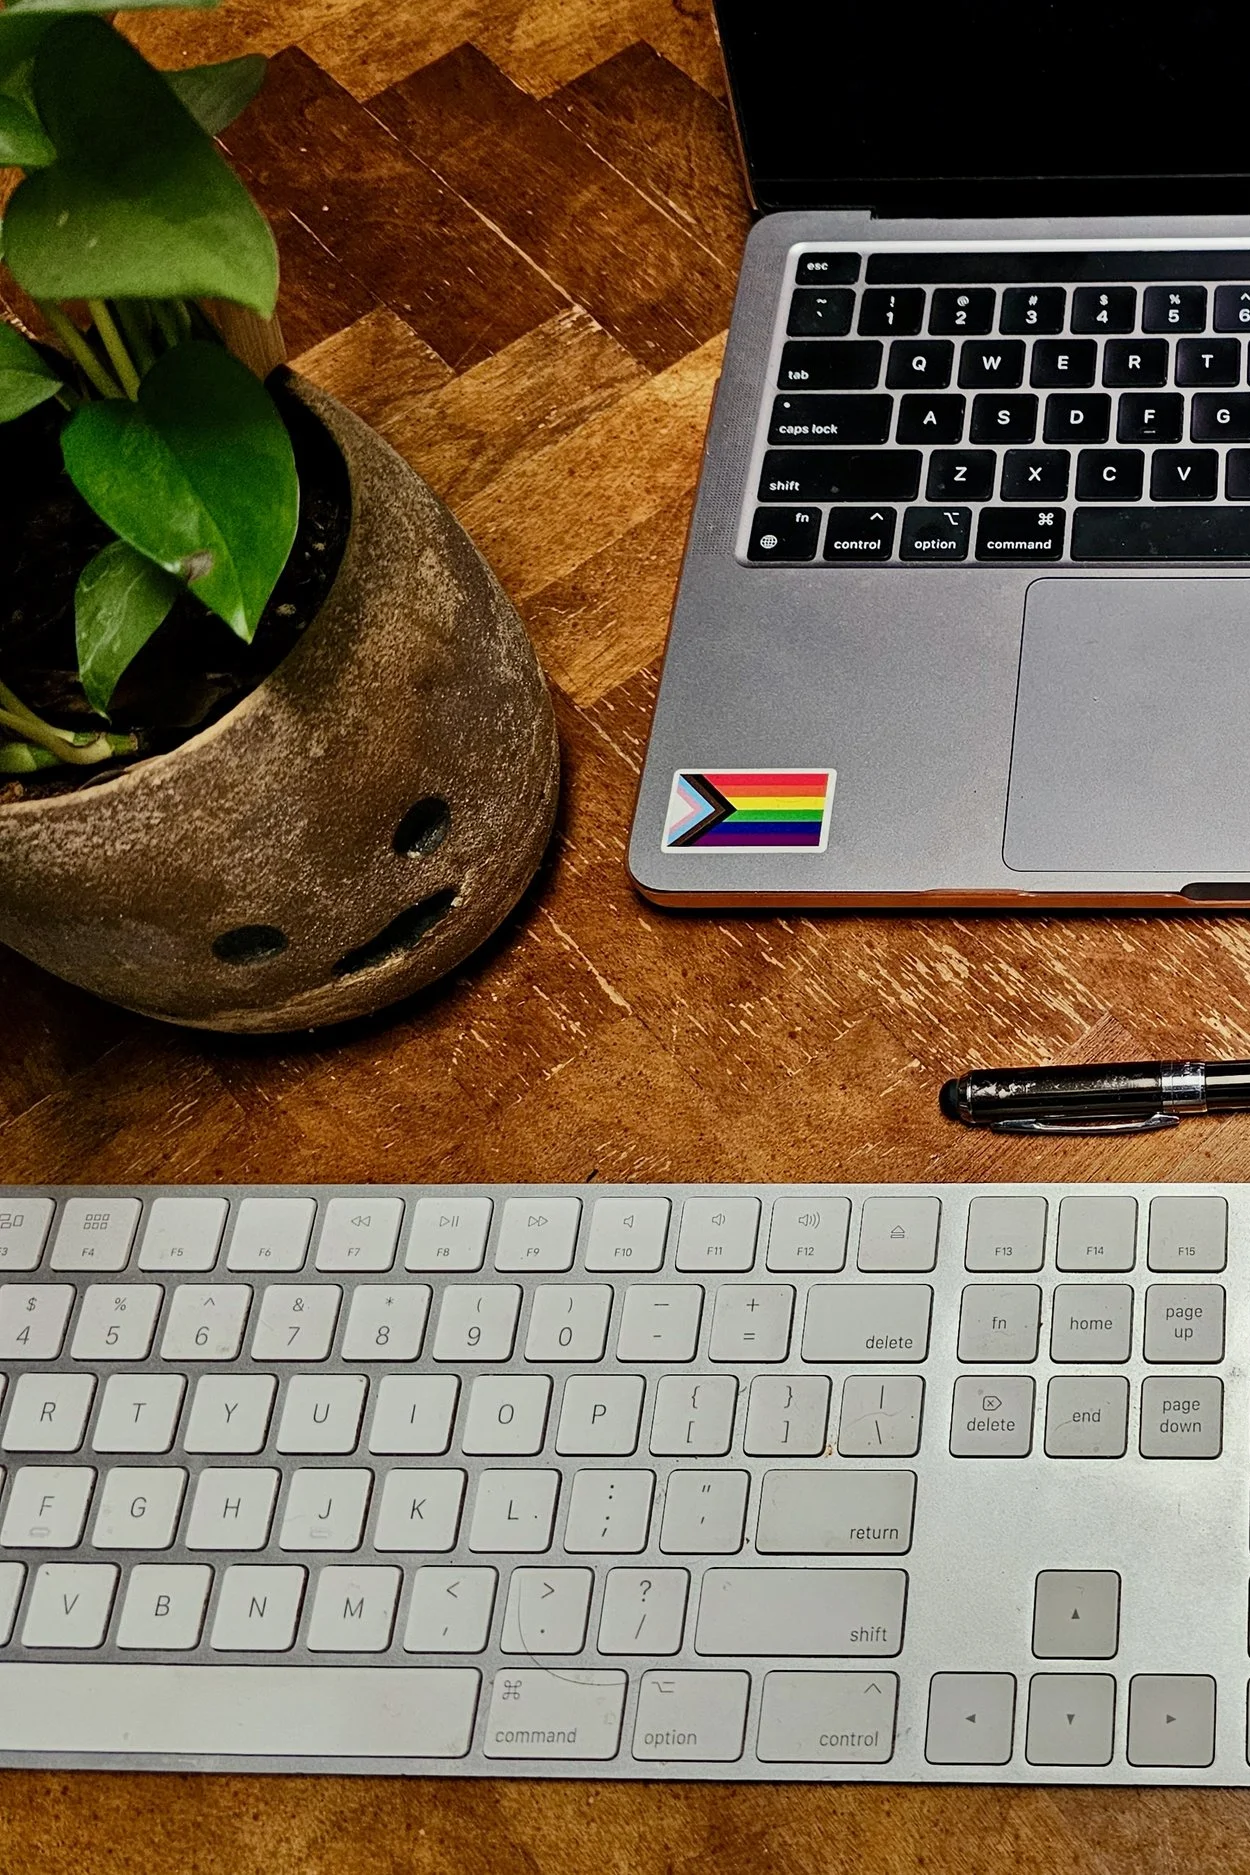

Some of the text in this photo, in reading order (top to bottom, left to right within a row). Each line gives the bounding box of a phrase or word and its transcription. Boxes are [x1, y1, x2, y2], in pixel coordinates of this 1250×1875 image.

[806, 262, 829, 271] esc
[955, 311, 966, 324] 2
[1026, 310, 1037, 324] 3
[1097, 310, 1108, 323] 4
[1168, 310, 1179, 322] 5
[1239, 309, 1250, 322] 6
[912, 356, 926, 371] Q
[983, 356, 1001, 370] W
[1058, 356, 1069, 369] E
[1129, 355, 1141, 368] R
[1202, 355, 1213, 368] T
[789, 370, 809, 379] tab
[923, 411, 936, 424] A
[998, 410, 1010, 424] S
[1070, 410, 1083, 424] D
[1145, 410, 1155, 423] F
[1217, 409, 1230, 423] G
[779, 424, 837, 435] caps lock
[954, 467, 967, 481] Z
[1028, 467, 1042, 481] X
[1103, 467, 1116, 481] C
[1178, 467, 1191, 480] V
[770, 481, 799, 491] shift
[796, 513, 809, 522] fn
[834, 540, 880, 549] control
[915, 539, 956, 550] option
[987, 540, 1051, 549] command
[82, 1248, 94, 1256] F4
[171, 1248, 183, 1256] F5
[259, 1248, 271, 1256] F6
[348, 1248, 360, 1256] F7
[437, 1248, 449, 1256] F8
[527, 1248, 539, 1256] F9
[615, 1248, 632, 1256] F10
[707, 1247, 722, 1255] F11
[797, 1247, 814, 1255] F12
[995, 1247, 1012, 1255] F13
[1087, 1247, 1103, 1255] F14
[1179, 1247, 1195, 1255] F15
[1166, 1308, 1202, 1320] page
[993, 1317, 1006, 1329] fn
[1071, 1317, 1112, 1329] home
[16, 1326, 30, 1344] 4
[106, 1326, 120, 1345] 5
[195, 1326, 209, 1345] 6
[288, 1327, 300, 1345] 7
[376, 1326, 390, 1345] 8
[467, 1327, 480, 1346] 9
[559, 1327, 572, 1346] 0
[1175, 1328, 1193, 1341] up
[866, 1336, 912, 1349] delete
[40, 1402, 56, 1421] R
[133, 1403, 146, 1422] T
[225, 1404, 238, 1423] Y
[314, 1404, 329, 1423] U
[499, 1404, 514, 1424] O
[1163, 1401, 1200, 1414] page
[592, 1405, 606, 1424] P
[1073, 1409, 1100, 1422] end
[967, 1418, 1015, 1431] delete
[1160, 1419, 1201, 1433] down
[39, 1496, 54, 1516] F
[131, 1497, 146, 1518] G
[223, 1498, 240, 1518] H
[319, 1499, 332, 1519] J
[411, 1499, 425, 1519] K
[508, 1500, 518, 1520] L
[851, 1527, 898, 1539] return
[64, 1594, 79, 1615] V
[155, 1595, 170, 1616] B
[249, 1597, 267, 1617] N
[344, 1598, 364, 1618] M
[850, 1627, 887, 1641] shift
[496, 1728, 576, 1743] command
[645, 1730, 696, 1748] option
[820, 1731, 878, 1746] control
